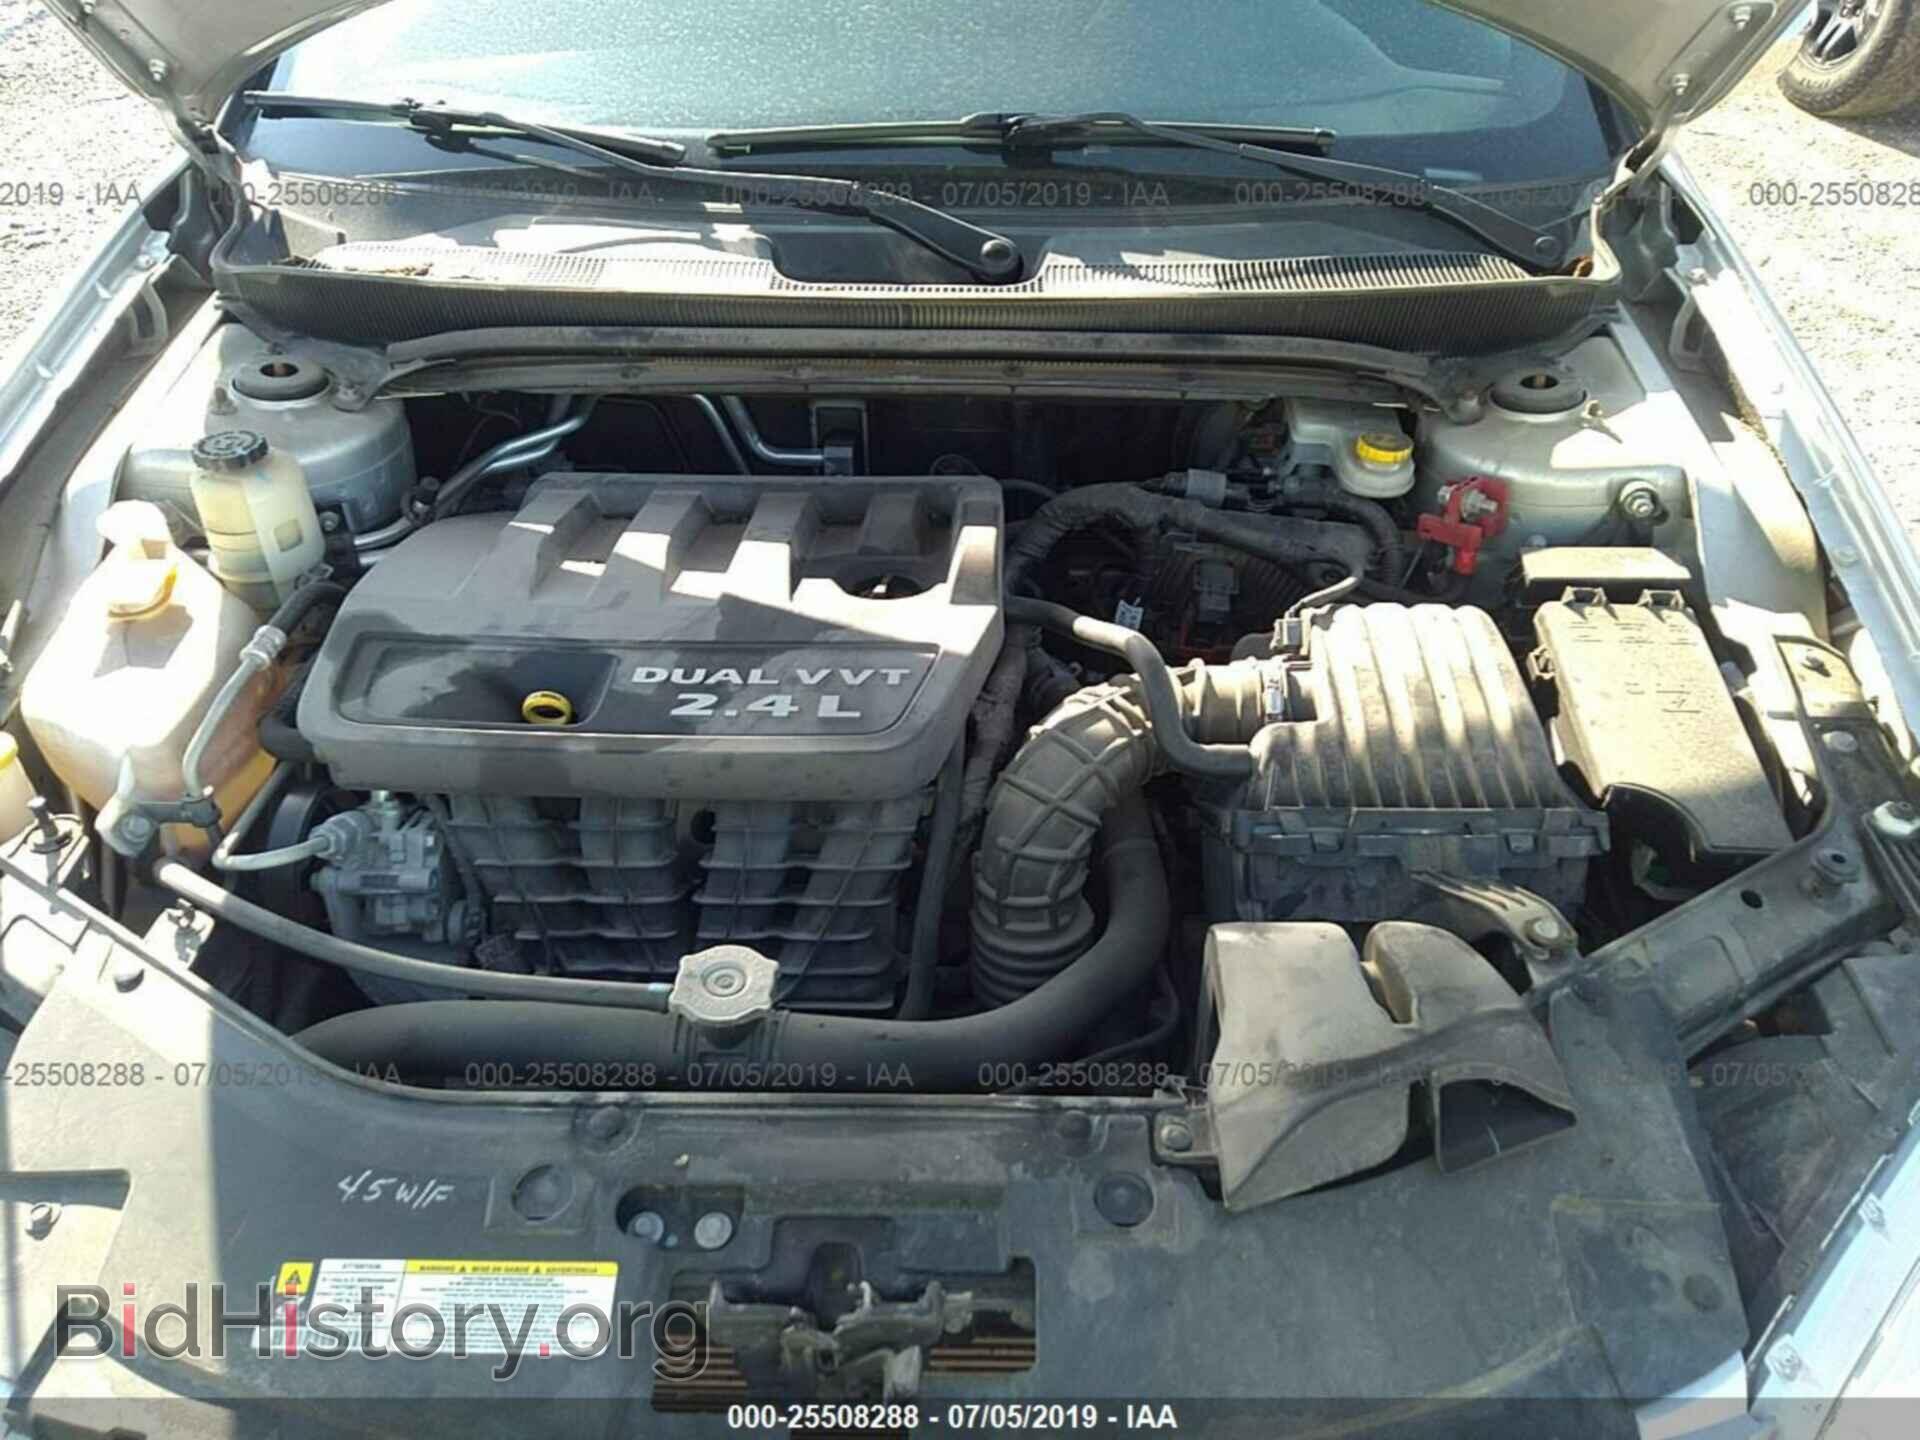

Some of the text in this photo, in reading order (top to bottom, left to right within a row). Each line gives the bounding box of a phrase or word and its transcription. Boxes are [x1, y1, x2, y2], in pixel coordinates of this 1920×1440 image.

[632, 667, 910, 685] DUAL VVT
[338, 1169, 398, 1203] 45
